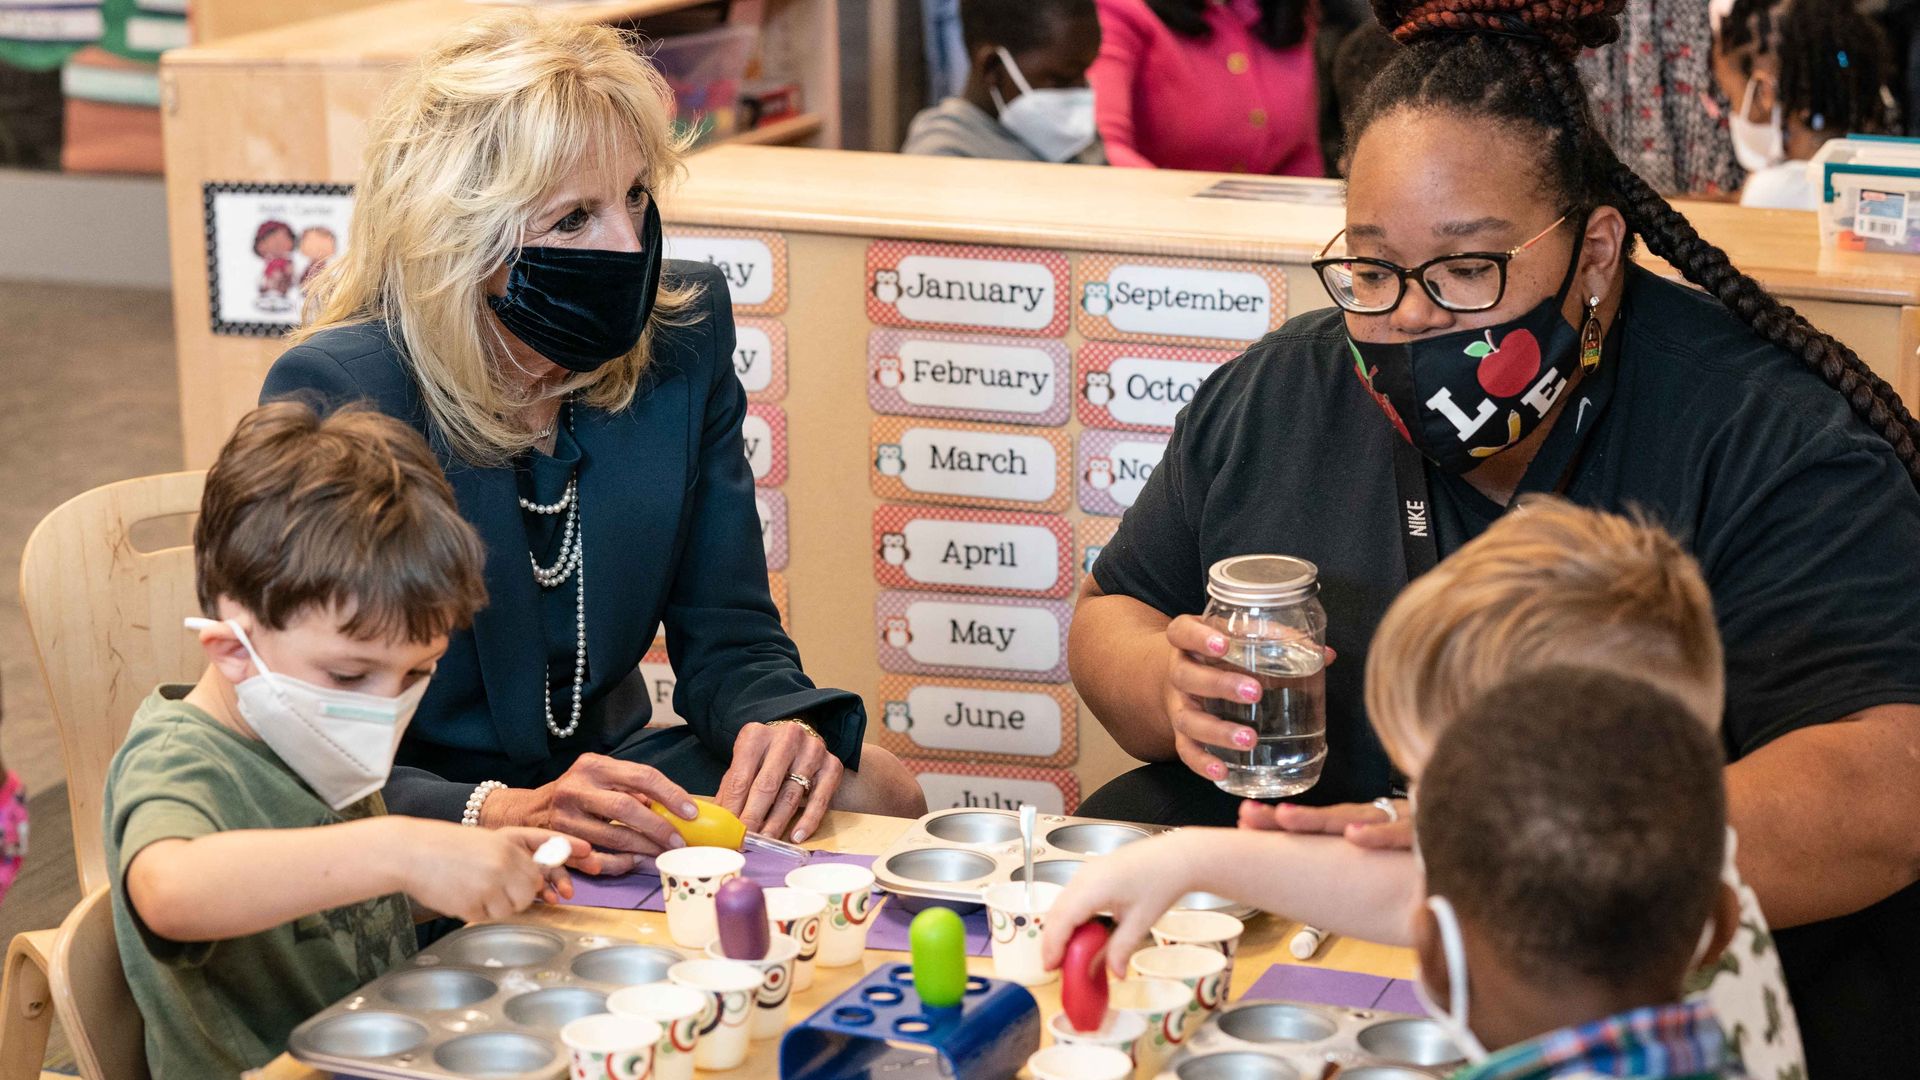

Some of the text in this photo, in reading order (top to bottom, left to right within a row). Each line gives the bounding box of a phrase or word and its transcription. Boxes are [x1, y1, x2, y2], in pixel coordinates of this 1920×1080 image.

[906, 273, 1045, 312] January
[1115, 281, 1263, 313] September
[913, 359, 1049, 396] February
[1127, 374, 1203, 401] Octo
[929, 444, 1028, 476] March
[1406, 500, 1428, 537] NIKE
[941, 539, 1018, 570] April
[949, 618, 1016, 652] May
[944, 702, 1025, 730] June
